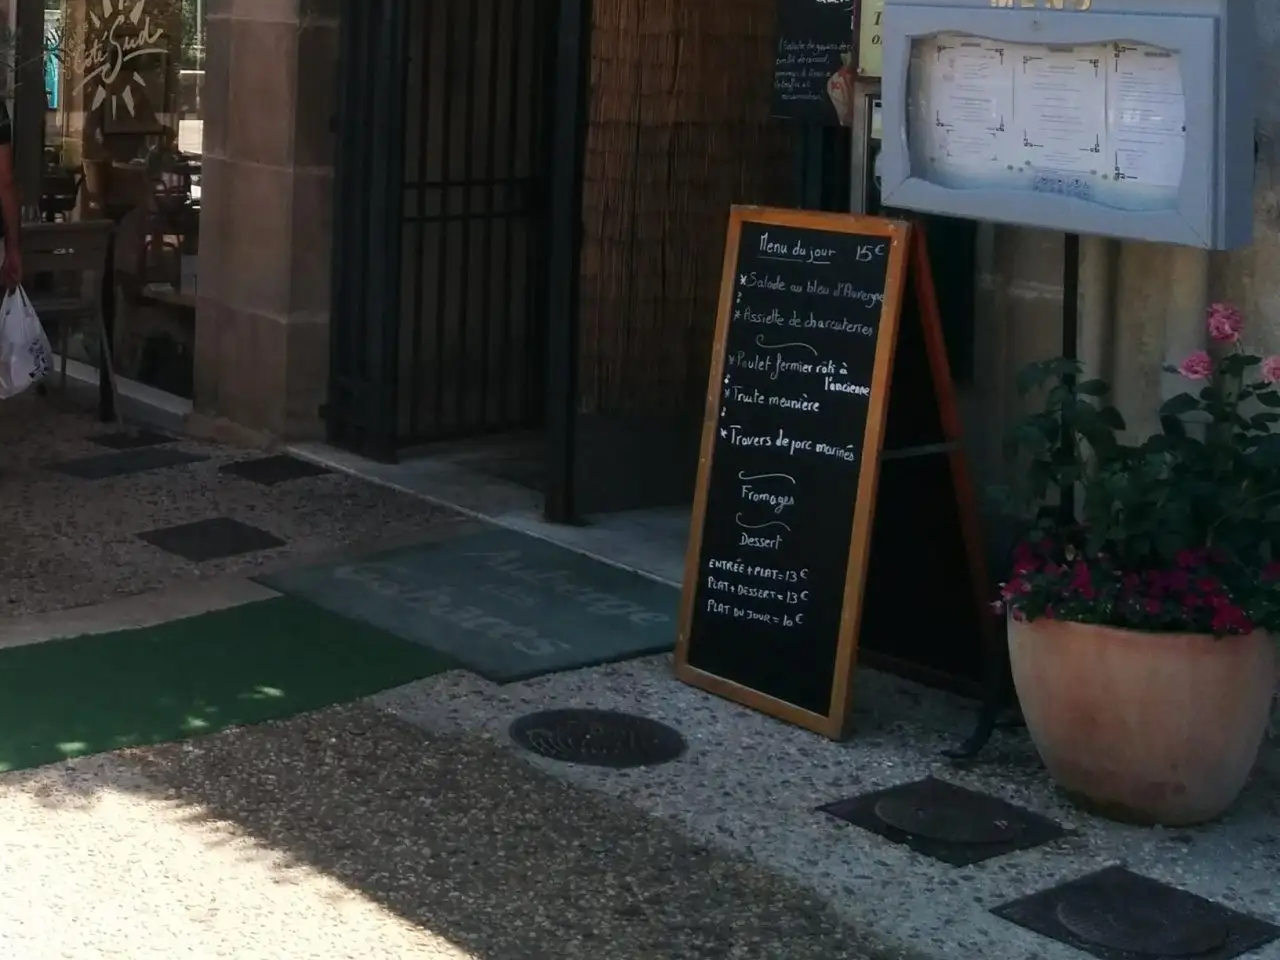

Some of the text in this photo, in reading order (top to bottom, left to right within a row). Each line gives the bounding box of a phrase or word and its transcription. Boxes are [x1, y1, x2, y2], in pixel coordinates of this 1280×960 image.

[759, 232, 787, 253] Menu
[792, 240, 806, 256] du
[806, 246, 836, 264] jour
[746, 271, 786, 291] Salade
[807, 280, 829, 295] bleu
[744, 306, 784, 326] Assiette
[788, 310, 802, 327] de
[737, 351, 771, 371] Poulet
[770, 352, 812, 380] fermier
[839, 362, 848, 375] à
[825, 376, 870, 397] l'ancienne
[769, 393, 820, 412] meunière
[730, 424, 854, 461] Travers de porc marinés
[741, 485, 795, 514] Fromages
[739, 532, 783, 550] Dessert
[707, 599, 730, 615] PLAT
[734, 607, 744, 618] DU
[746, 610, 770, 623] JOUR
